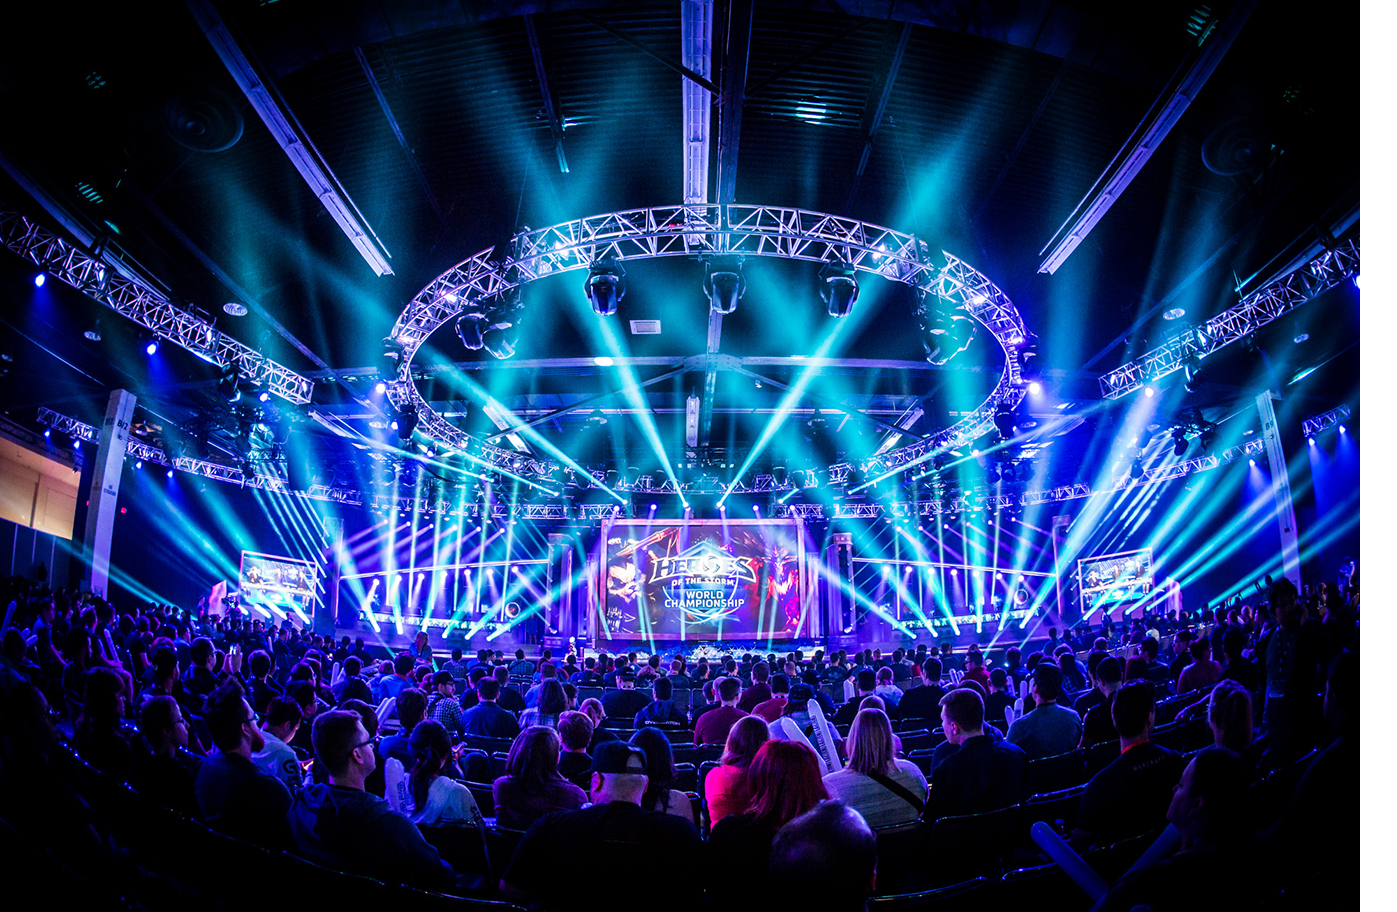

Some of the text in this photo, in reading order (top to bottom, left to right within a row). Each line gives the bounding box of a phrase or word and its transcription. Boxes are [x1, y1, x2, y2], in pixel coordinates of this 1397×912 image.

[649, 556, 756, 584] HEROES
[671, 576, 735, 587] OF THE STORM
[686, 590, 724, 600] WORLD
[664, 599, 745, 608] CHAMPIONSHIP
